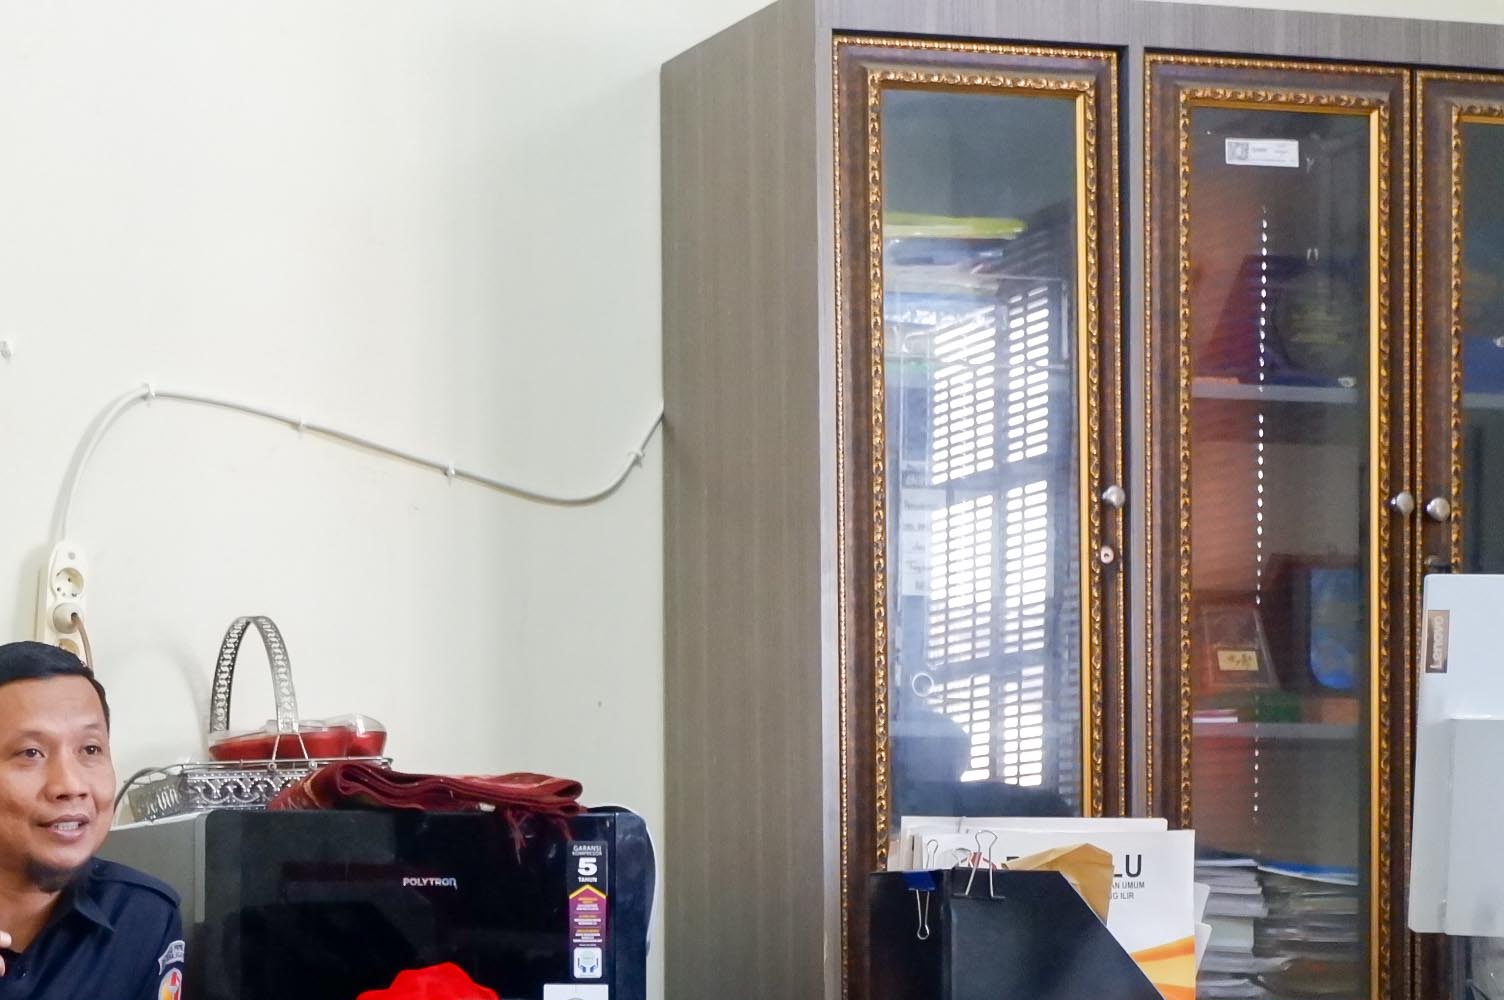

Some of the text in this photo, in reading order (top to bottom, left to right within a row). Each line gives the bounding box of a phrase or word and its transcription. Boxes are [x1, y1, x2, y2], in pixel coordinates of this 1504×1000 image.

[1429, 615, 1445, 669] Lenovo
[577, 856, 598, 876] 5
[1122, 881, 1145, 890] UMUM
[1120, 891, 1135, 900] ILIR
